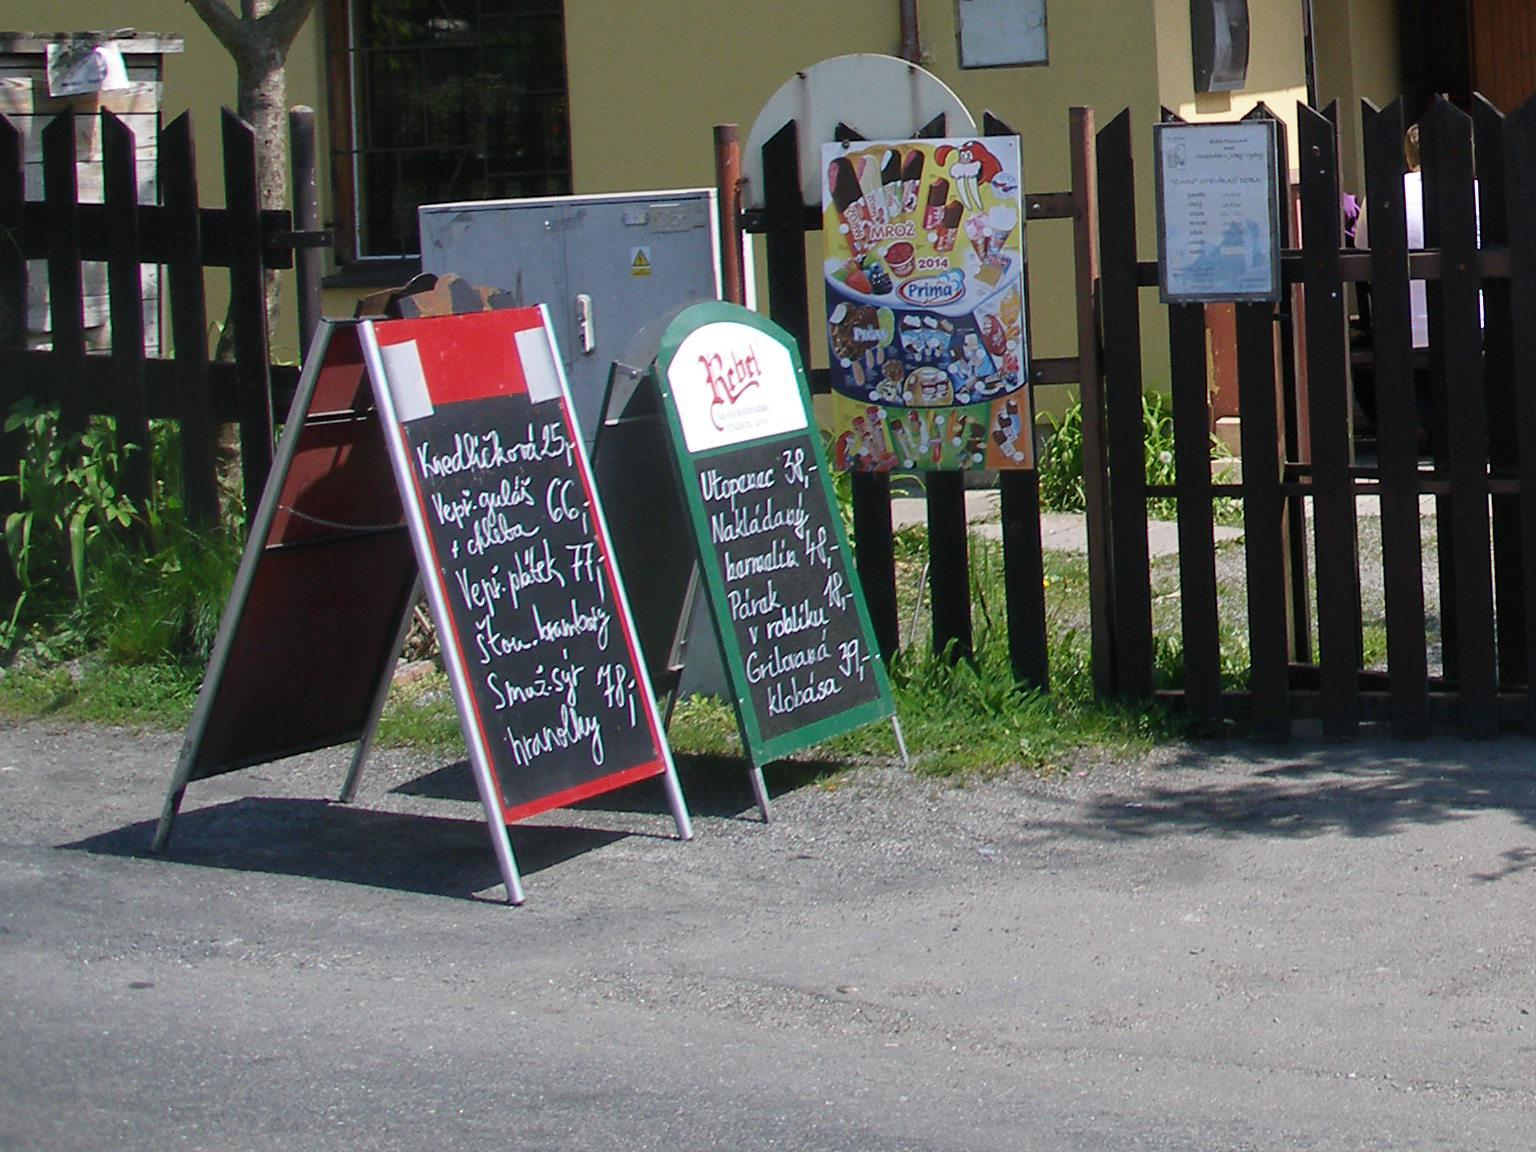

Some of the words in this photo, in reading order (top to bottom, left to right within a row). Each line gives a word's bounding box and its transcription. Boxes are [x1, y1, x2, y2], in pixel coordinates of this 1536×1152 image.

[918, 258, 949, 269] 2014
[908, 283, 953, 298] Prima
[698, 344, 761, 420] Rebel
[478, 476, 535, 526] guláš
[701, 468, 775, 512] Utopenec
[783, 448, 818, 488] 38,-
[712, 492, 810, 544] Nakládaný
[725, 538, 800, 582] hermelín
[805, 526, 839, 569] 48,-
[727, 580, 780, 621] Párek
[823, 571, 854, 611] 18,-
[746, 628, 832, 684] Grilovaná
[838, 639, 870, 682] 39,-
